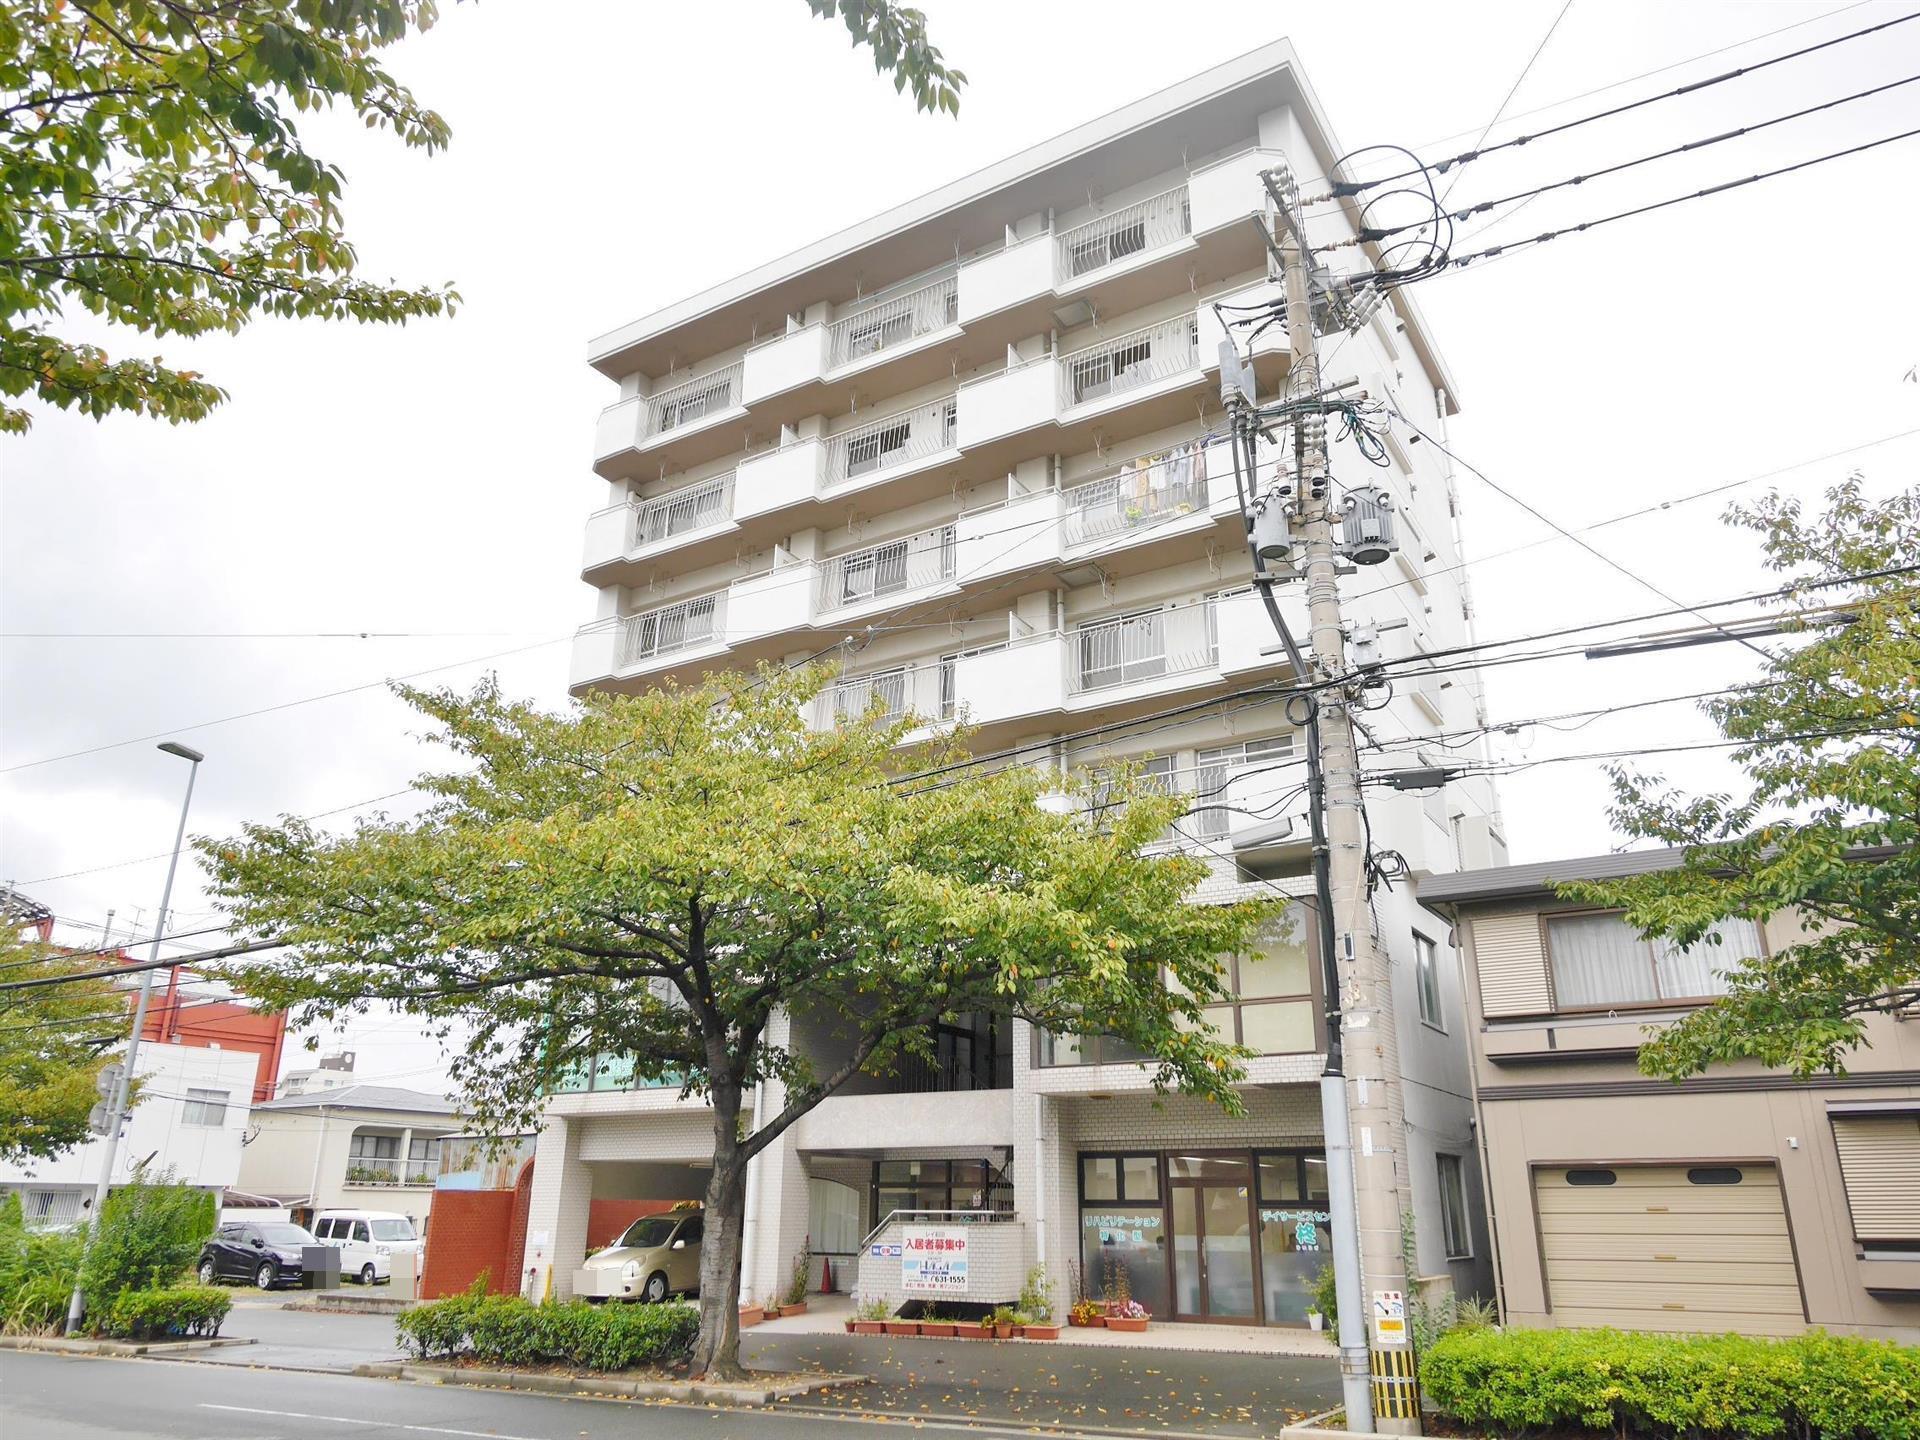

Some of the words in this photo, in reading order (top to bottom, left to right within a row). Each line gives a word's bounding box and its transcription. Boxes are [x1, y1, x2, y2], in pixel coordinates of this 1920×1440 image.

[905, 1238, 965, 1251] 入居者募集中
